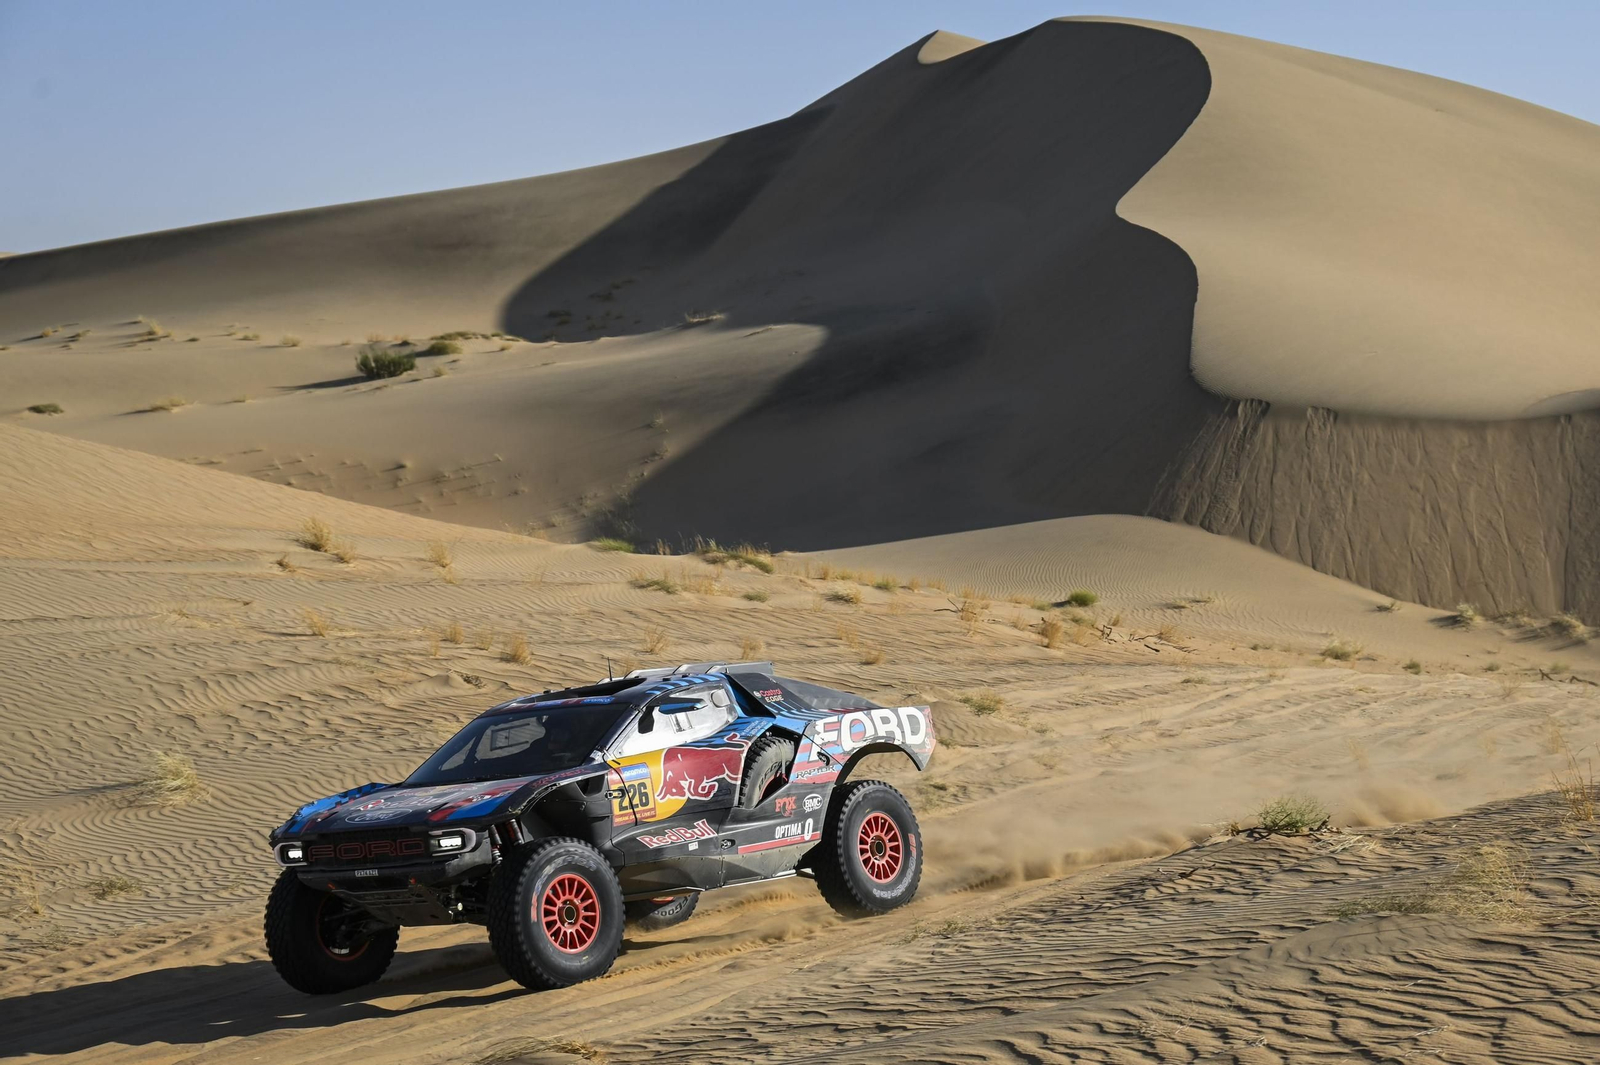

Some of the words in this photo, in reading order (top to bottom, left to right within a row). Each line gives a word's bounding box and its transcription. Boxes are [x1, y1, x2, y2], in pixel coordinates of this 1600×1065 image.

[808, 706, 926, 762] FORD
[618, 781, 650, 812] 226
[775, 796, 797, 817] FOX
[804, 797, 821, 809] BMC
[775, 822, 802, 839] OPTIMA
[307, 838, 425, 862] FORD
